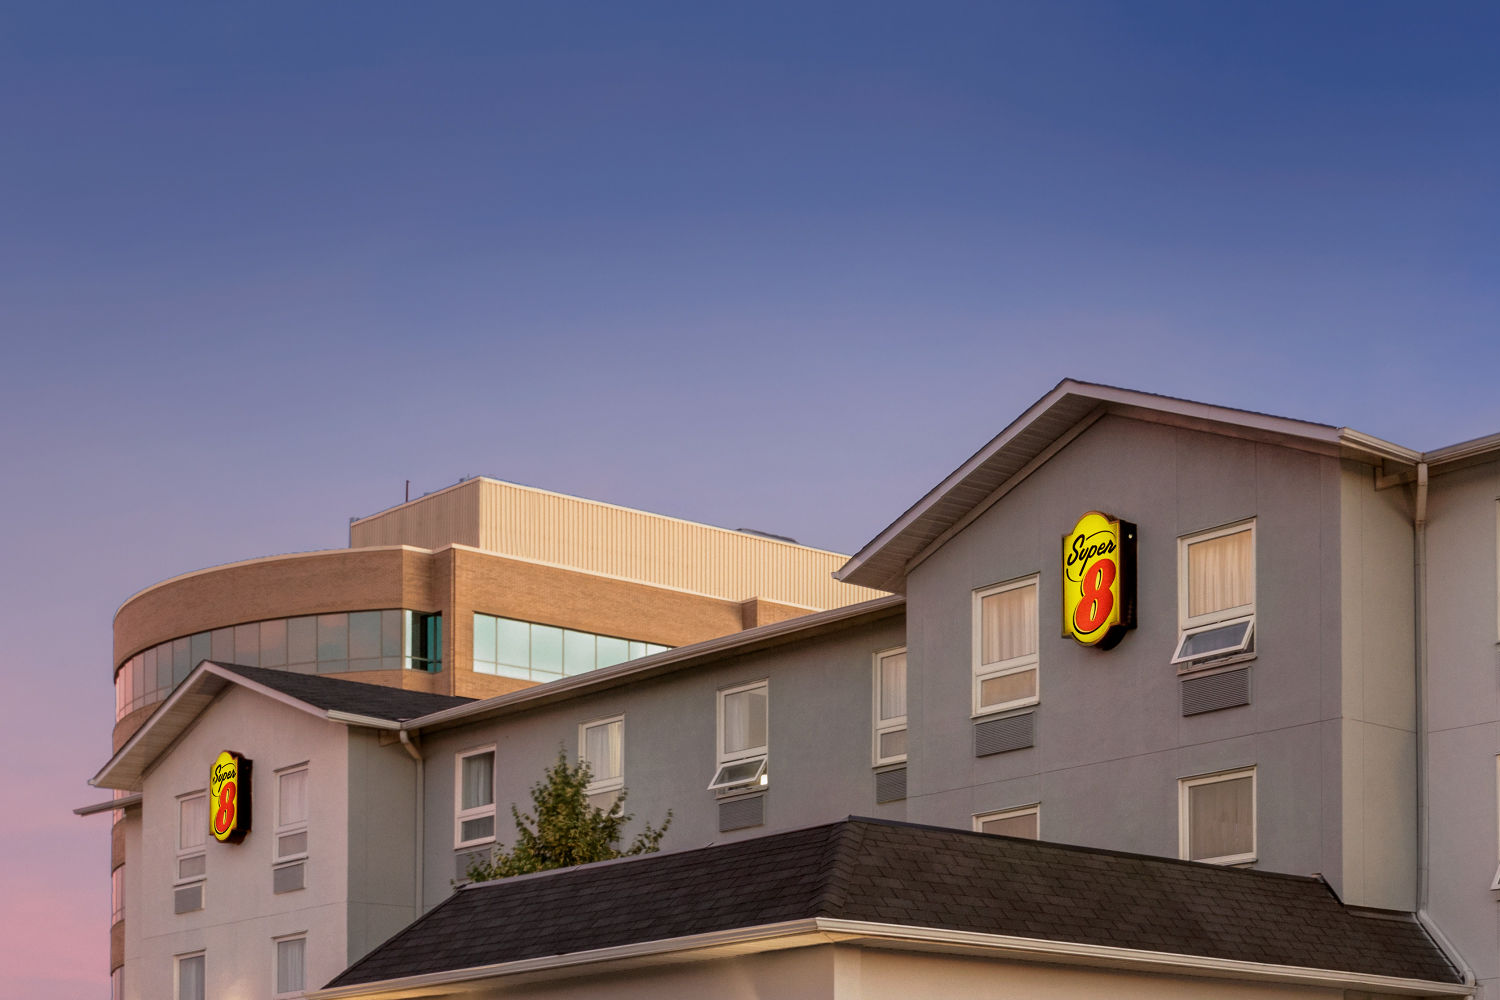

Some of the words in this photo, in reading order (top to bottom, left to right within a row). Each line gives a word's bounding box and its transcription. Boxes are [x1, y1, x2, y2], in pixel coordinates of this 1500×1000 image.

[1067, 534, 1117, 577] Super
[1073, 559, 1117, 634] 8
[213, 764, 236, 793] Super
[214, 782, 236, 834] 8
